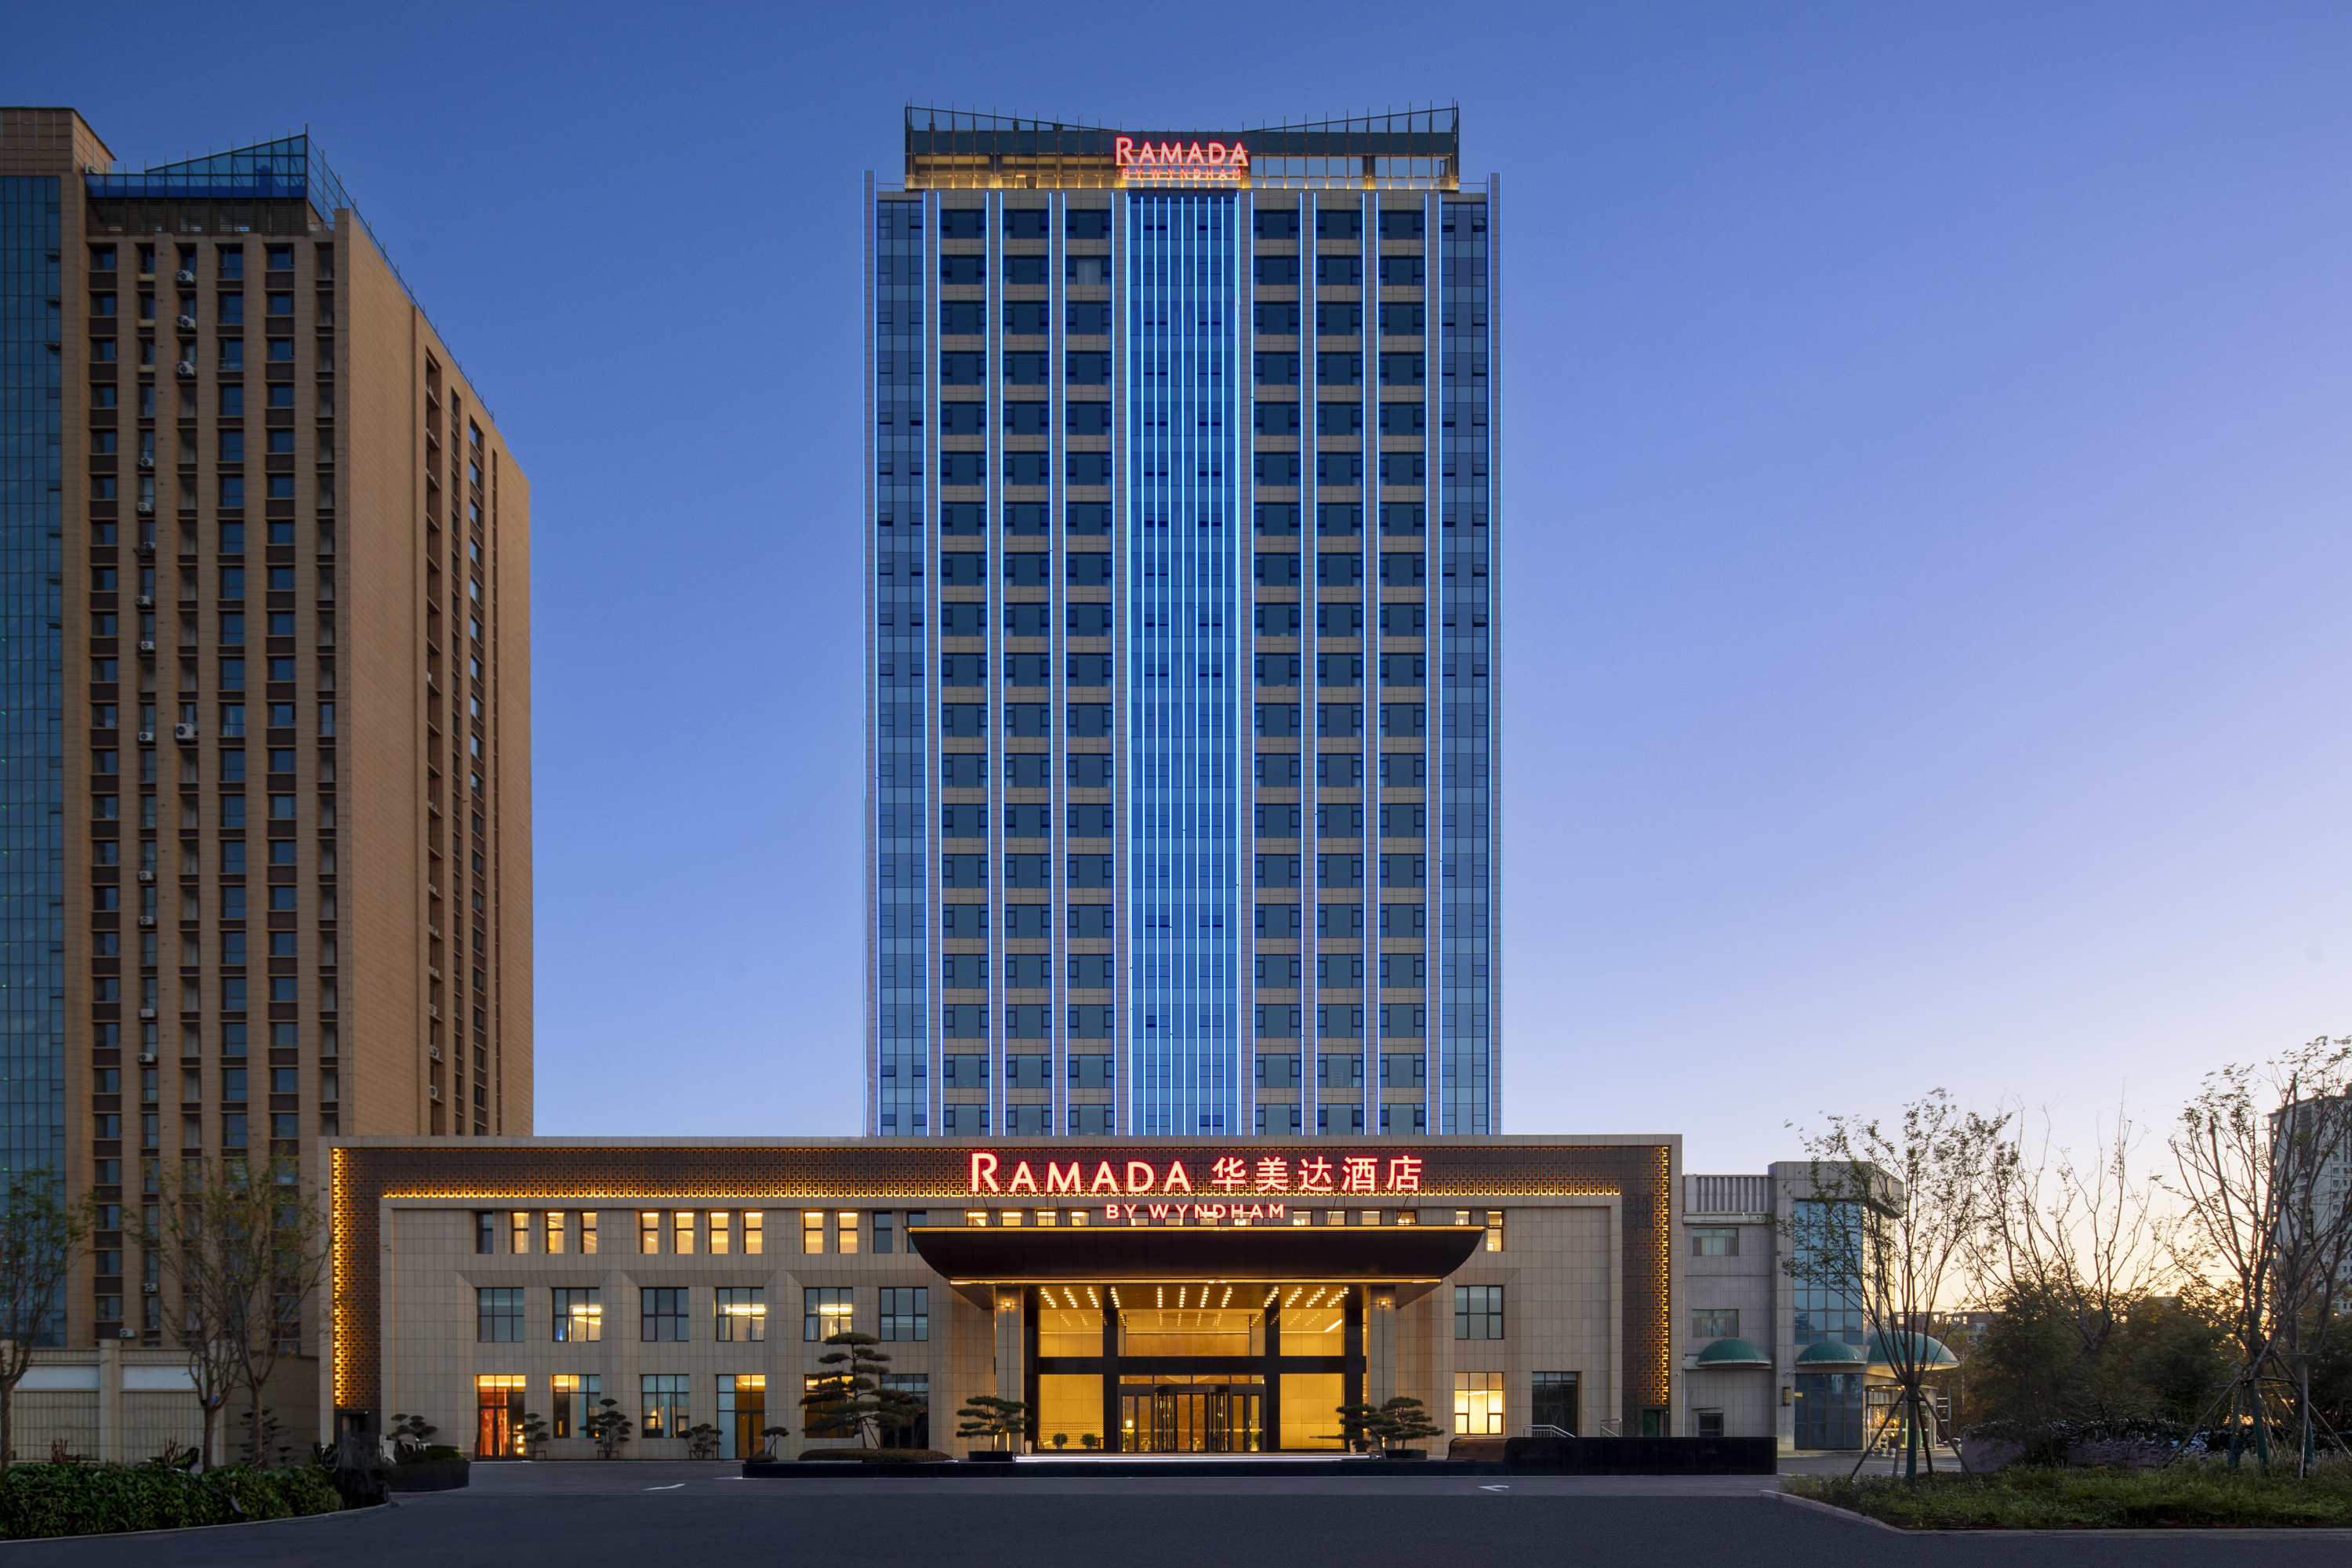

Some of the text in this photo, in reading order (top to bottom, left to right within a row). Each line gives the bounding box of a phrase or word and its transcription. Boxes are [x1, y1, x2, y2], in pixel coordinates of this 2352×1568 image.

[1116, 136, 1248, 165] RAMADA
[1122, 168, 1241, 180] BY WYNDHAM
[971, 1152, 1191, 1192] RAMADA
[1211, 1155, 1422, 1192] 华美达酒店
[1106, 1203, 1284, 1218] BY WYNDHAM
